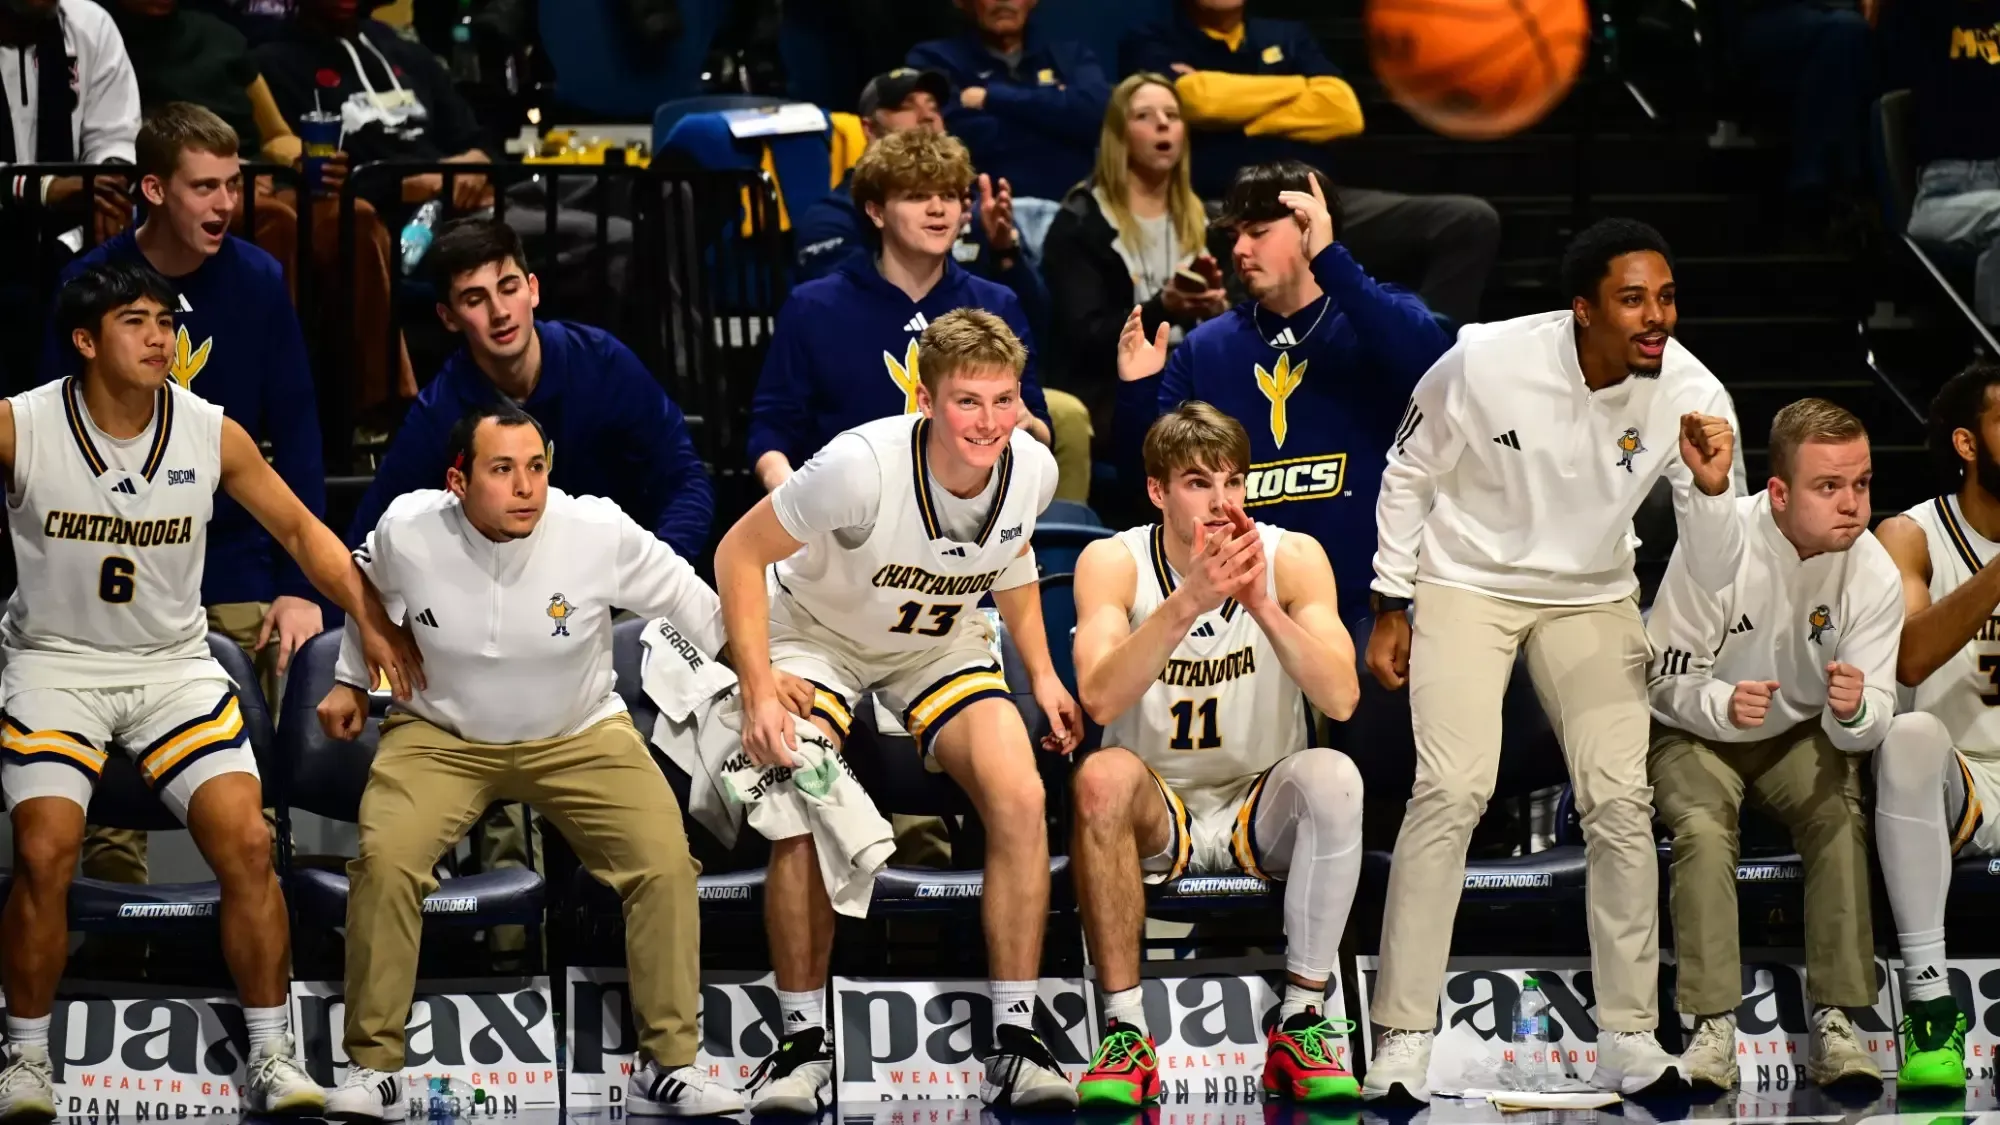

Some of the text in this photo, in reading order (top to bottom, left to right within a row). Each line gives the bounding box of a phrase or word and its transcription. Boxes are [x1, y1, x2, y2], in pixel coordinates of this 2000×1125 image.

[168, 468, 196, 486] SOCON
[44, 510, 193, 548] CHATTANOOGA
[98, 554, 136, 604] 6
[888, 600, 964, 638] 13
[659, 619, 705, 674] ERADE
[1170, 698, 1223, 750] 11
[1465, 875, 1549, 888] CHATTANOOGA
[697, 887, 748, 899] ANOOGA
[917, 885, 983, 897] CHATTANO
[121, 904, 213, 917] CHATTANOOGA
[423, 899, 474, 912] ANOOGA
[1738, 1039, 1797, 1054] ALTH
[1157, 1052, 1246, 1068] EALTH
[1533, 1049, 1597, 1063] GROU
[471, 1071, 554, 1085] GROUP
[890, 1071, 984, 1084] WEALT
[81, 1073, 246, 1098] WEALTH GRO
